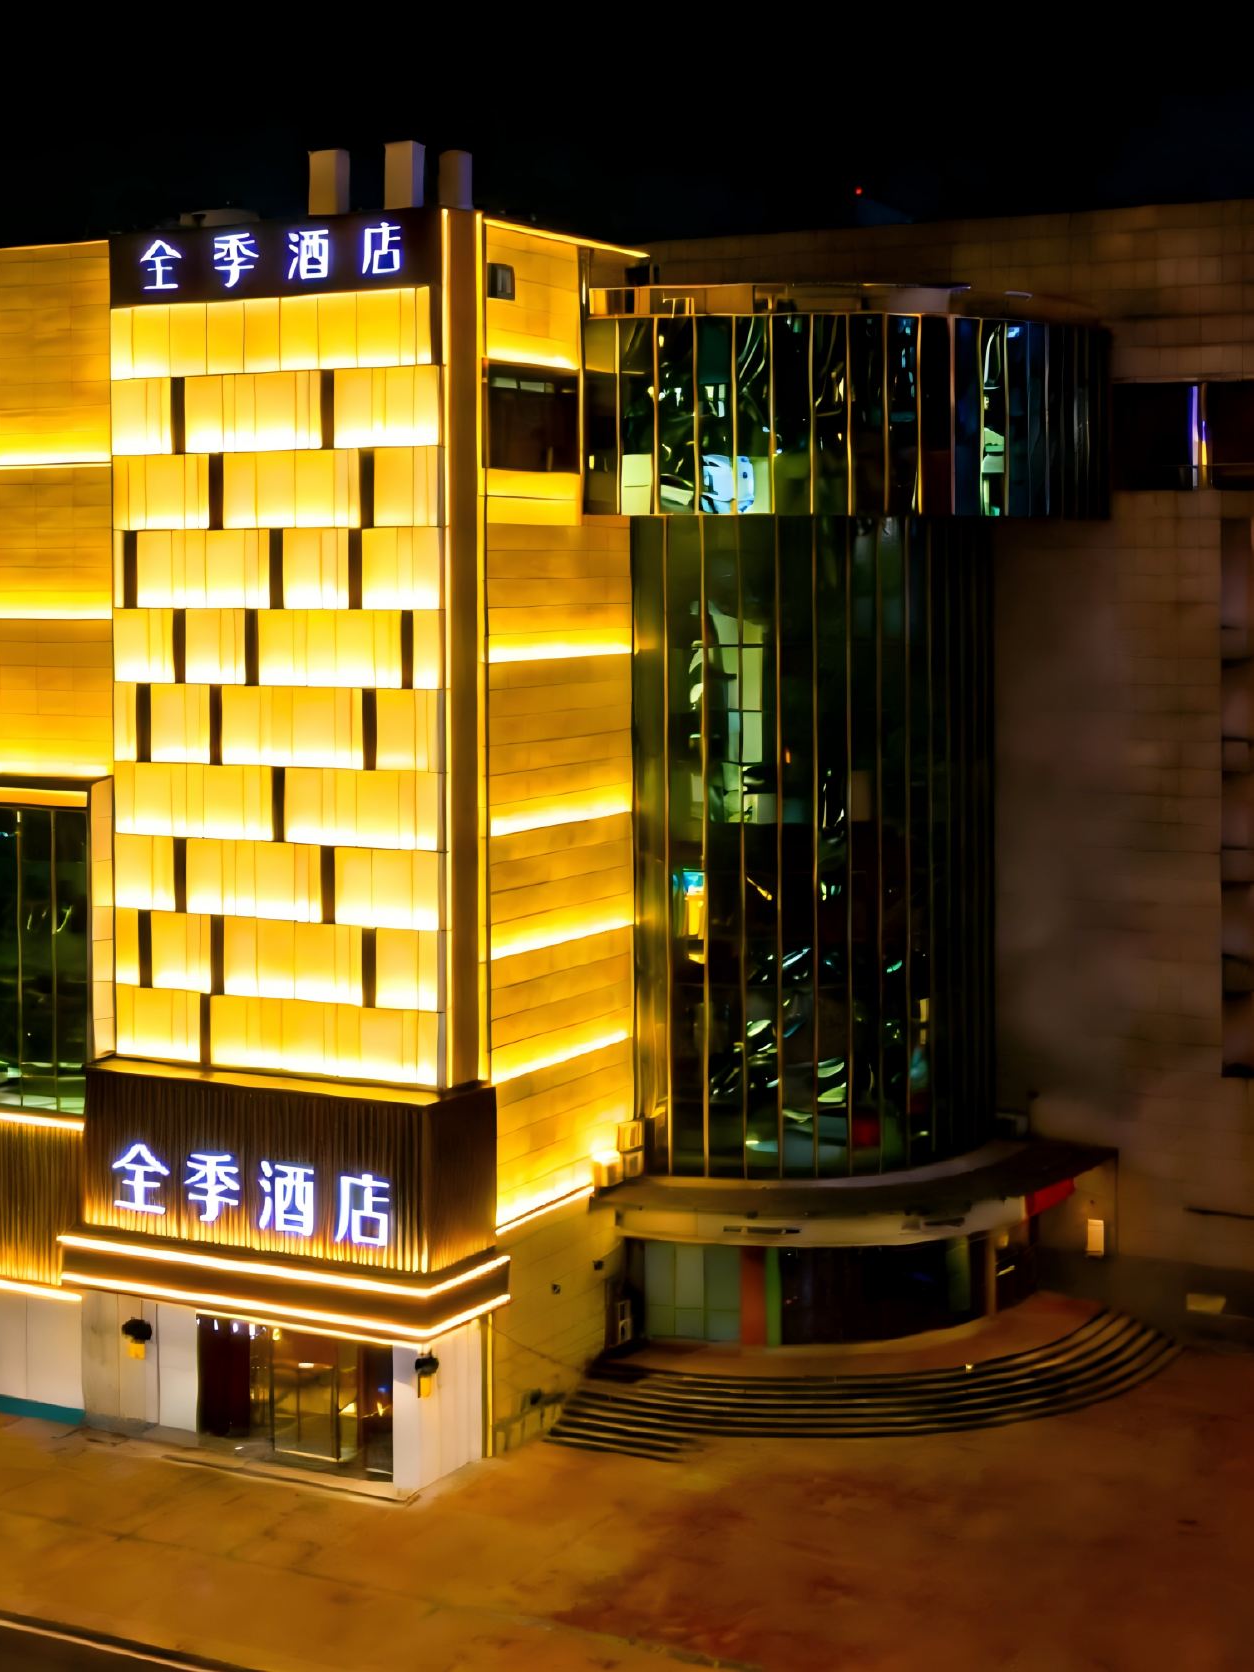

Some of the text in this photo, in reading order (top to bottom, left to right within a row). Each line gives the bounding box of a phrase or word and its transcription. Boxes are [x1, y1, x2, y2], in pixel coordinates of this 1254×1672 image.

[140, 222, 403, 290] 全季酒店
[112, 1143, 390, 1247] 全季酒店
